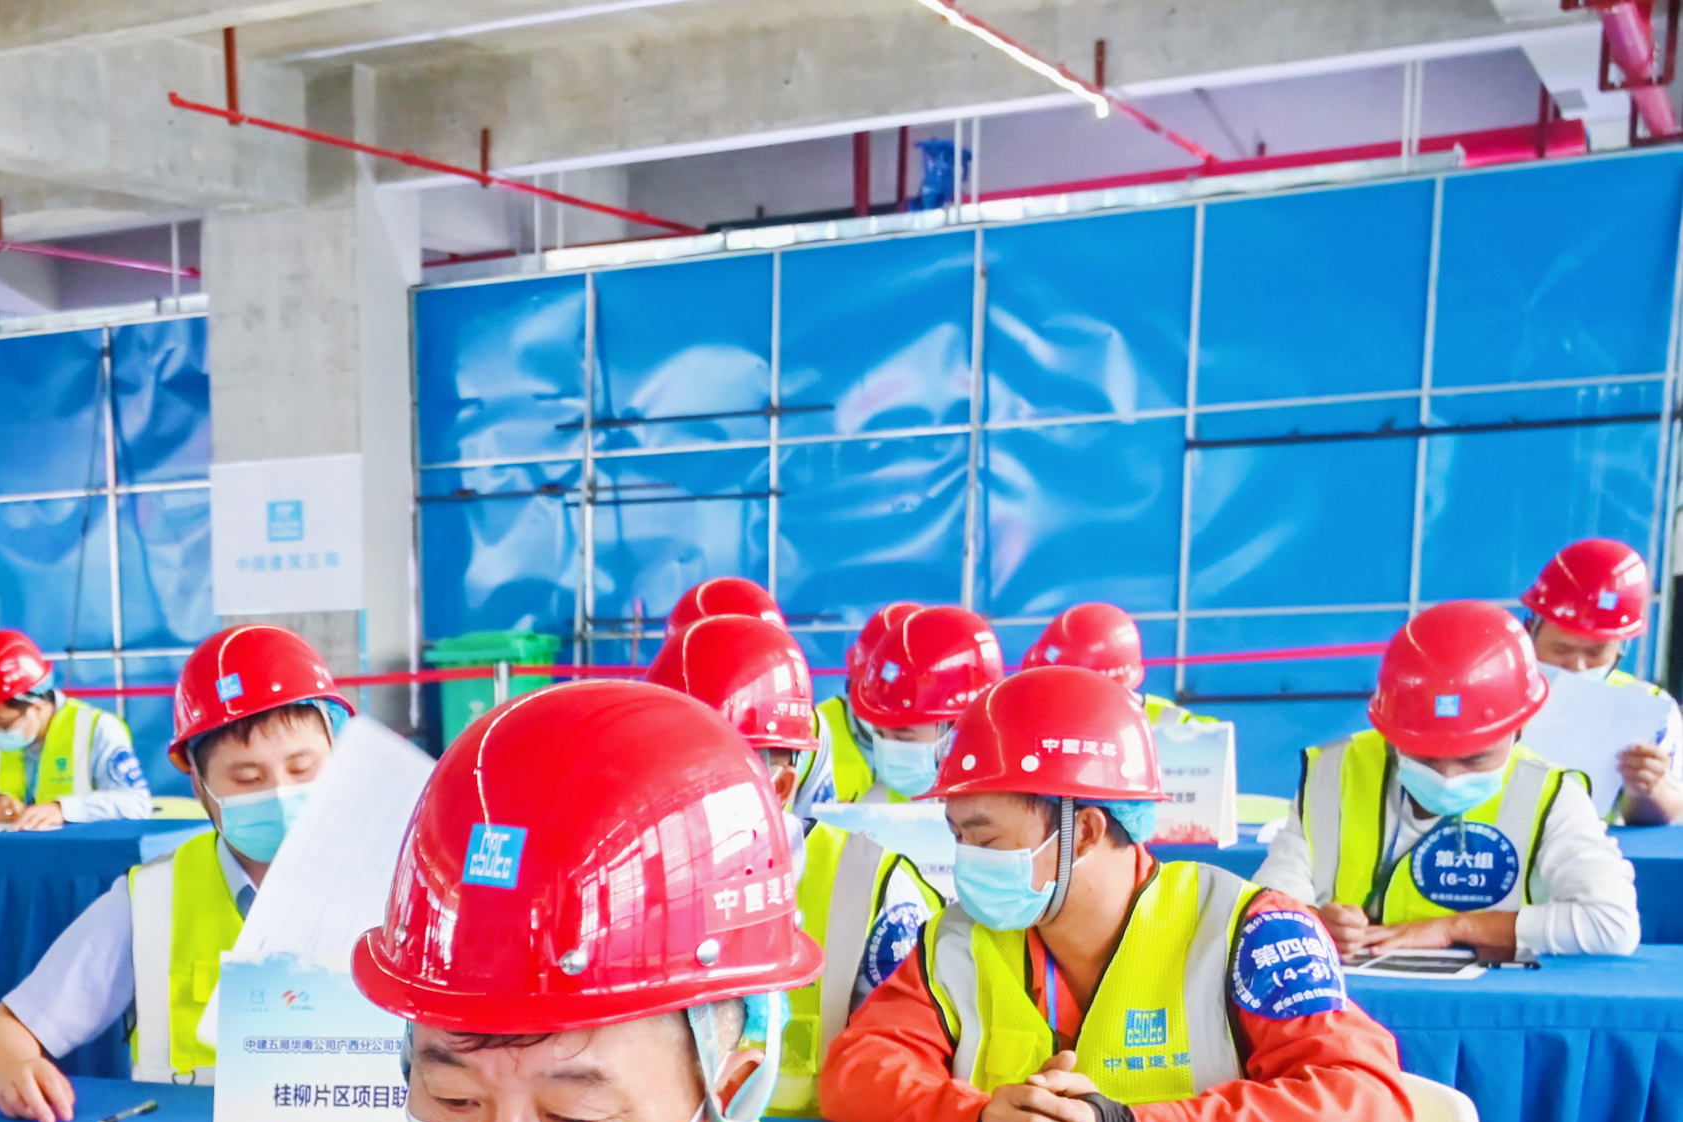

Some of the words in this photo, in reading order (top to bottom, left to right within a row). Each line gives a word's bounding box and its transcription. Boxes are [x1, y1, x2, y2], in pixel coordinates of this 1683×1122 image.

[1435, 850, 1493, 870] 第六组
[1439, 871, 1486, 887] (6-3)
[1251, 936, 1328, 970] 第四组
[1272, 962, 1331, 988] (4-3)
[274, 1082, 408, 1108] 桂柳片区项目联
